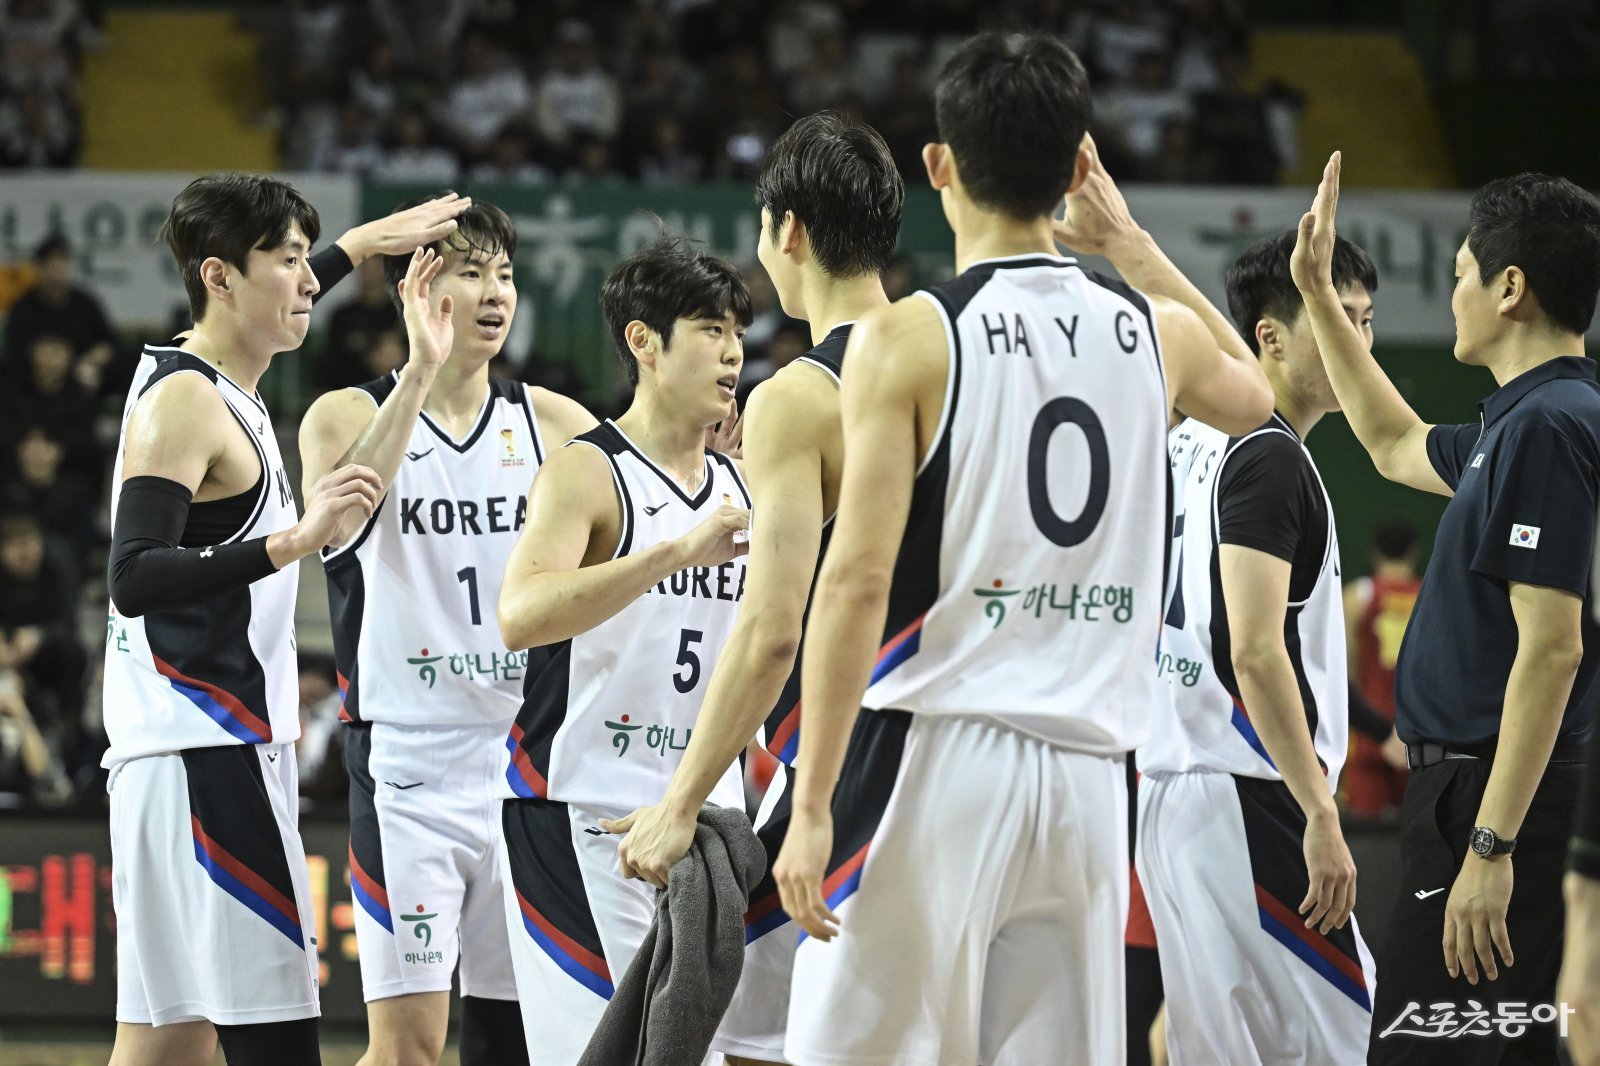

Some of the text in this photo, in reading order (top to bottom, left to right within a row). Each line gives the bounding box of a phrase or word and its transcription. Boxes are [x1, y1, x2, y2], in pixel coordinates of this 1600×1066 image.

[981, 310, 1138, 358] HA Y G
[1027, 396, 1110, 547] 0
[400, 495, 527, 536] KOREA
[457, 566, 482, 625] 1
[646, 561, 747, 602] ORE
[1022, 583, 1133, 623] 하나은행
[672, 628, 703, 694] 5
